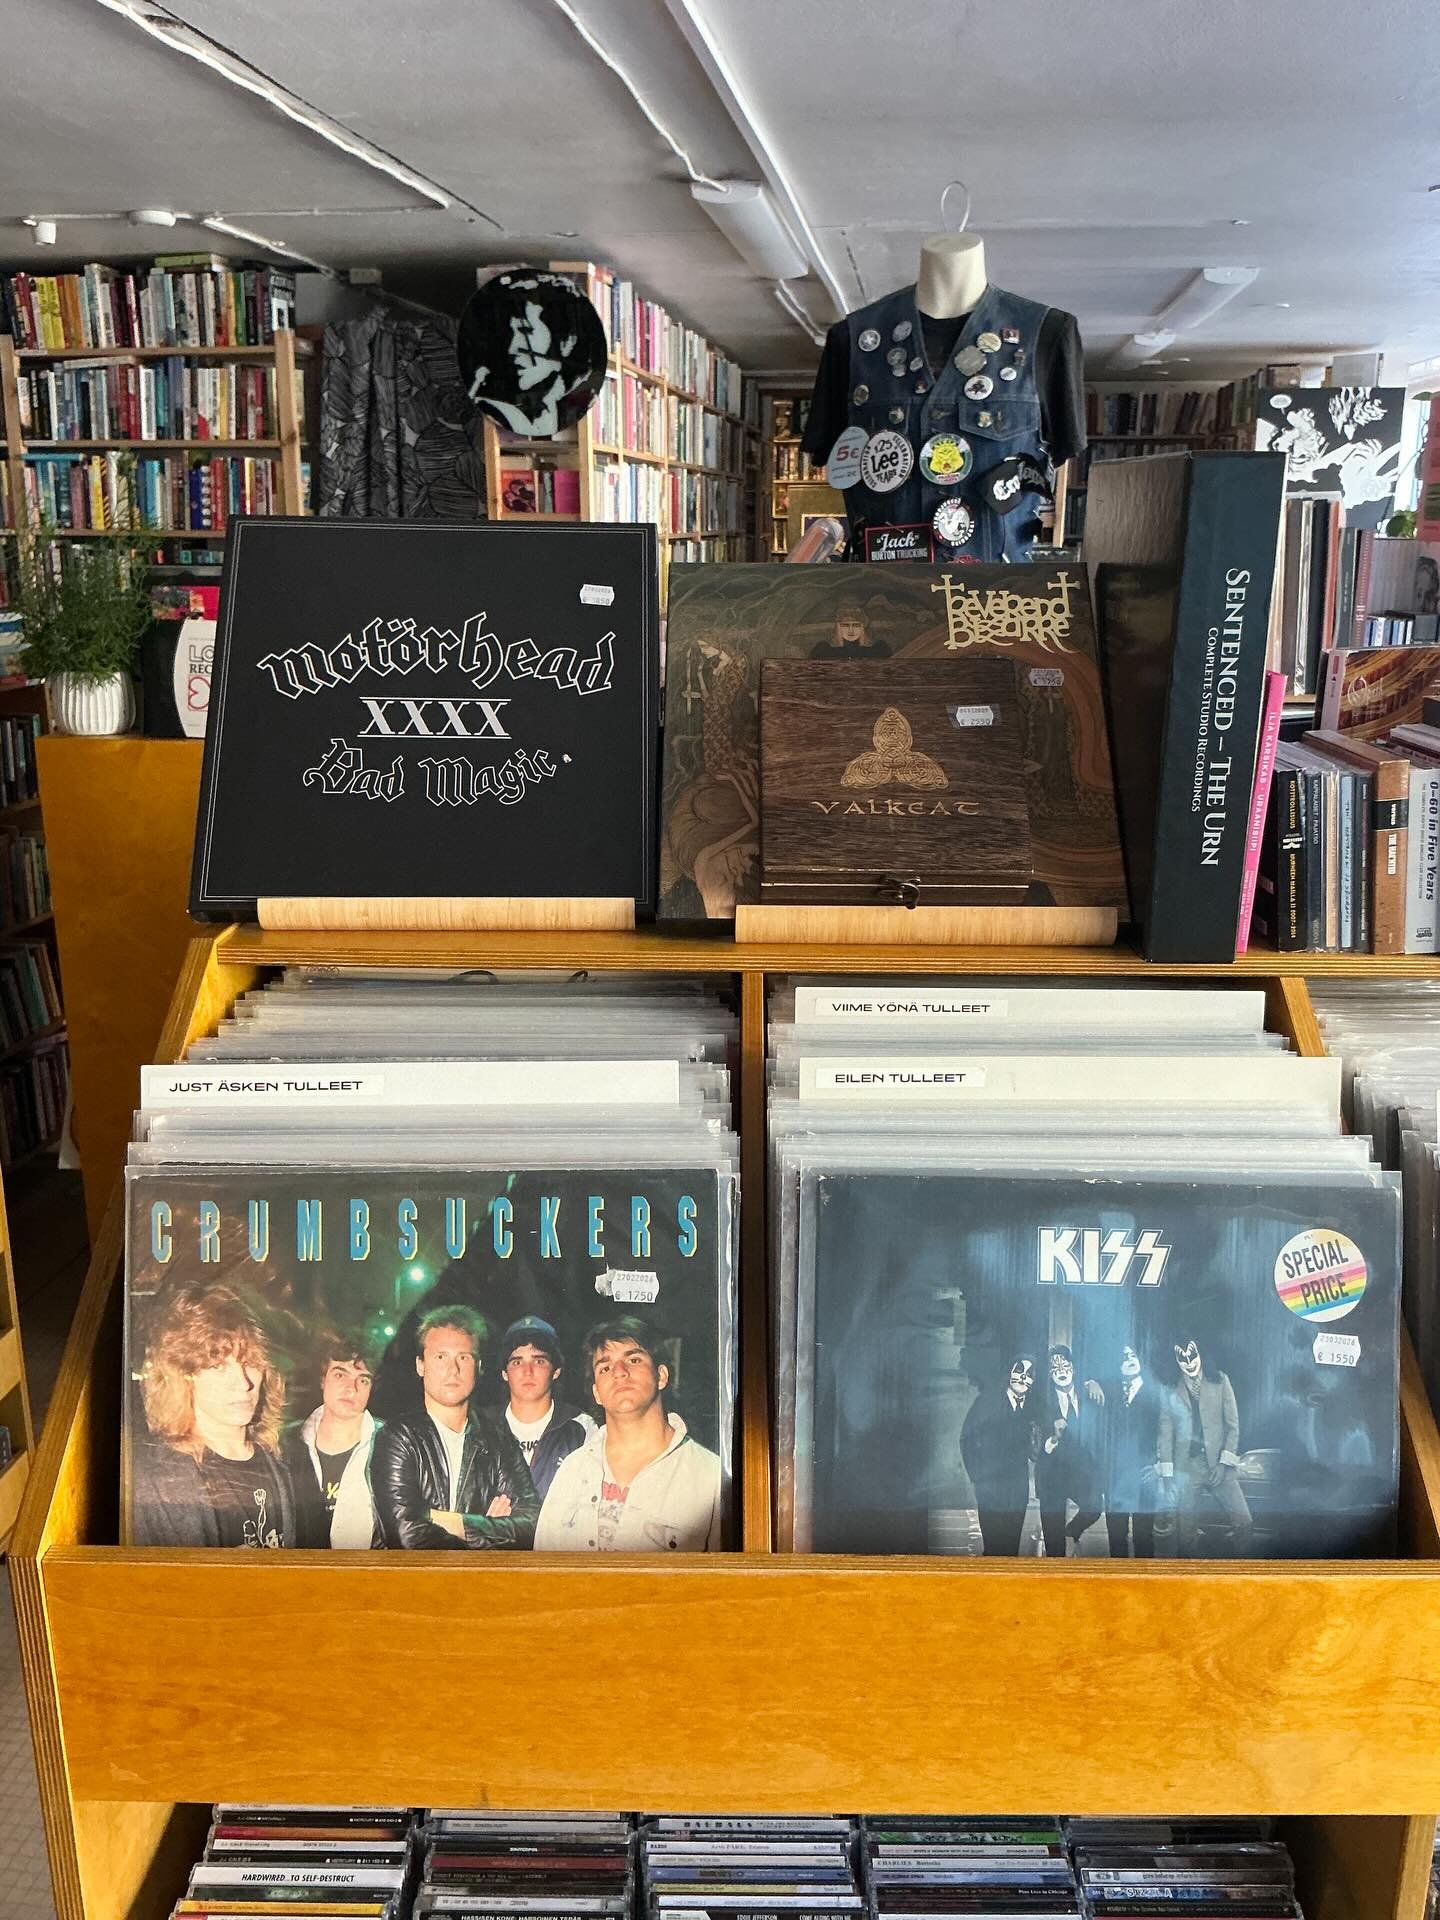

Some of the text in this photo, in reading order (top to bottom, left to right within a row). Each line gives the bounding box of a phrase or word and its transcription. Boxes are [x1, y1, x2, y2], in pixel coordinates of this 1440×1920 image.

[871, 451, 899, 473] Lee
[871, 550, 896, 561] BURTON
[256, 611, 616, 700] Motörhead
[1213, 568, 1251, 731] SENTENCED
[359, 699, 511, 736] XXXX
[1191, 627, 1219, 813] COMPLETE STUDIO RECORDINGS
[302, 738, 559, 807] Bad Magic
[1207, 757, 1232, 807] THE
[811, 799, 980, 816] VALKEAT
[1200, 812, 1226, 867] URN
[1425, 781, 1439, 901] 0-60 in Five Years
[831, 1001, 991, 1013] VIIME YÖNÄ TULLEET
[168, 1079, 363, 1092] JUST ÄSKEN TULLEET
[834, 1073, 967, 1083] EILEN TULLEET
[151, 1196, 698, 1263] CRUMBSUCKERS
[1037, 1226, 1172, 1287] KISS
[1281, 1238, 1349, 1279] SPECIAL
[615, 1290, 654, 1302] € 1750
[1300, 1273, 1350, 1308] PRICE
[1317, 1351, 1355, 1365] € 1550
[302, 1874, 355, 1883] SELF-DESTRUCT
